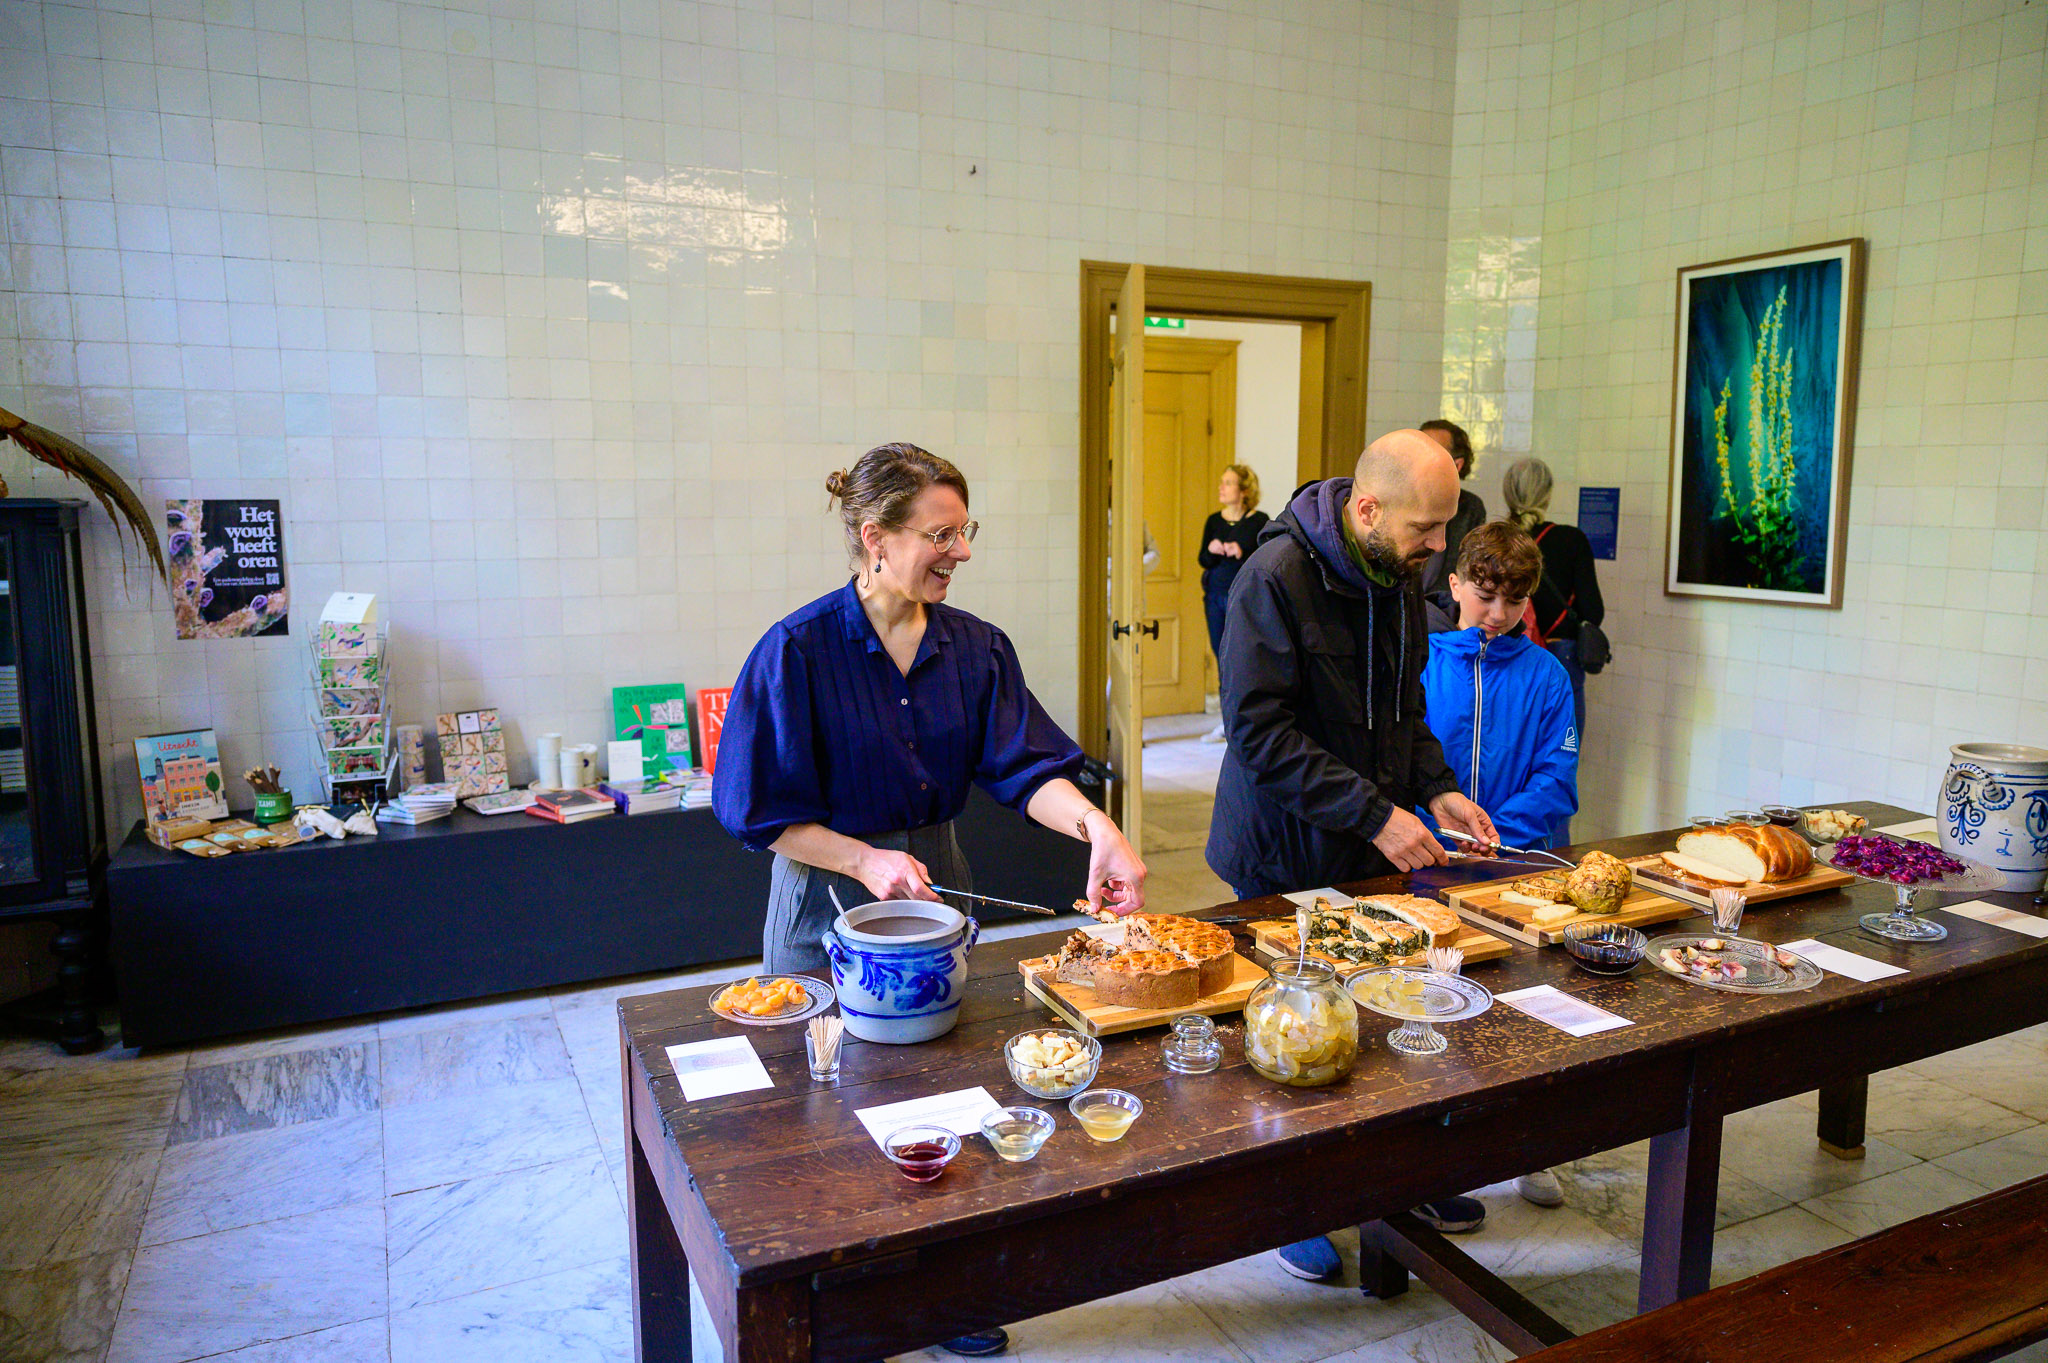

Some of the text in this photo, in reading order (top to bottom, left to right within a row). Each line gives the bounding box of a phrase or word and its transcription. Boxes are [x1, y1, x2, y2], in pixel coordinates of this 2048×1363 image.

[239, 506, 275, 523] Het
[224, 522, 276, 538] woud
[232, 537, 277, 553] heeft
[237, 556, 278, 568] oren
[157, 738, 199, 751] Utrecht
